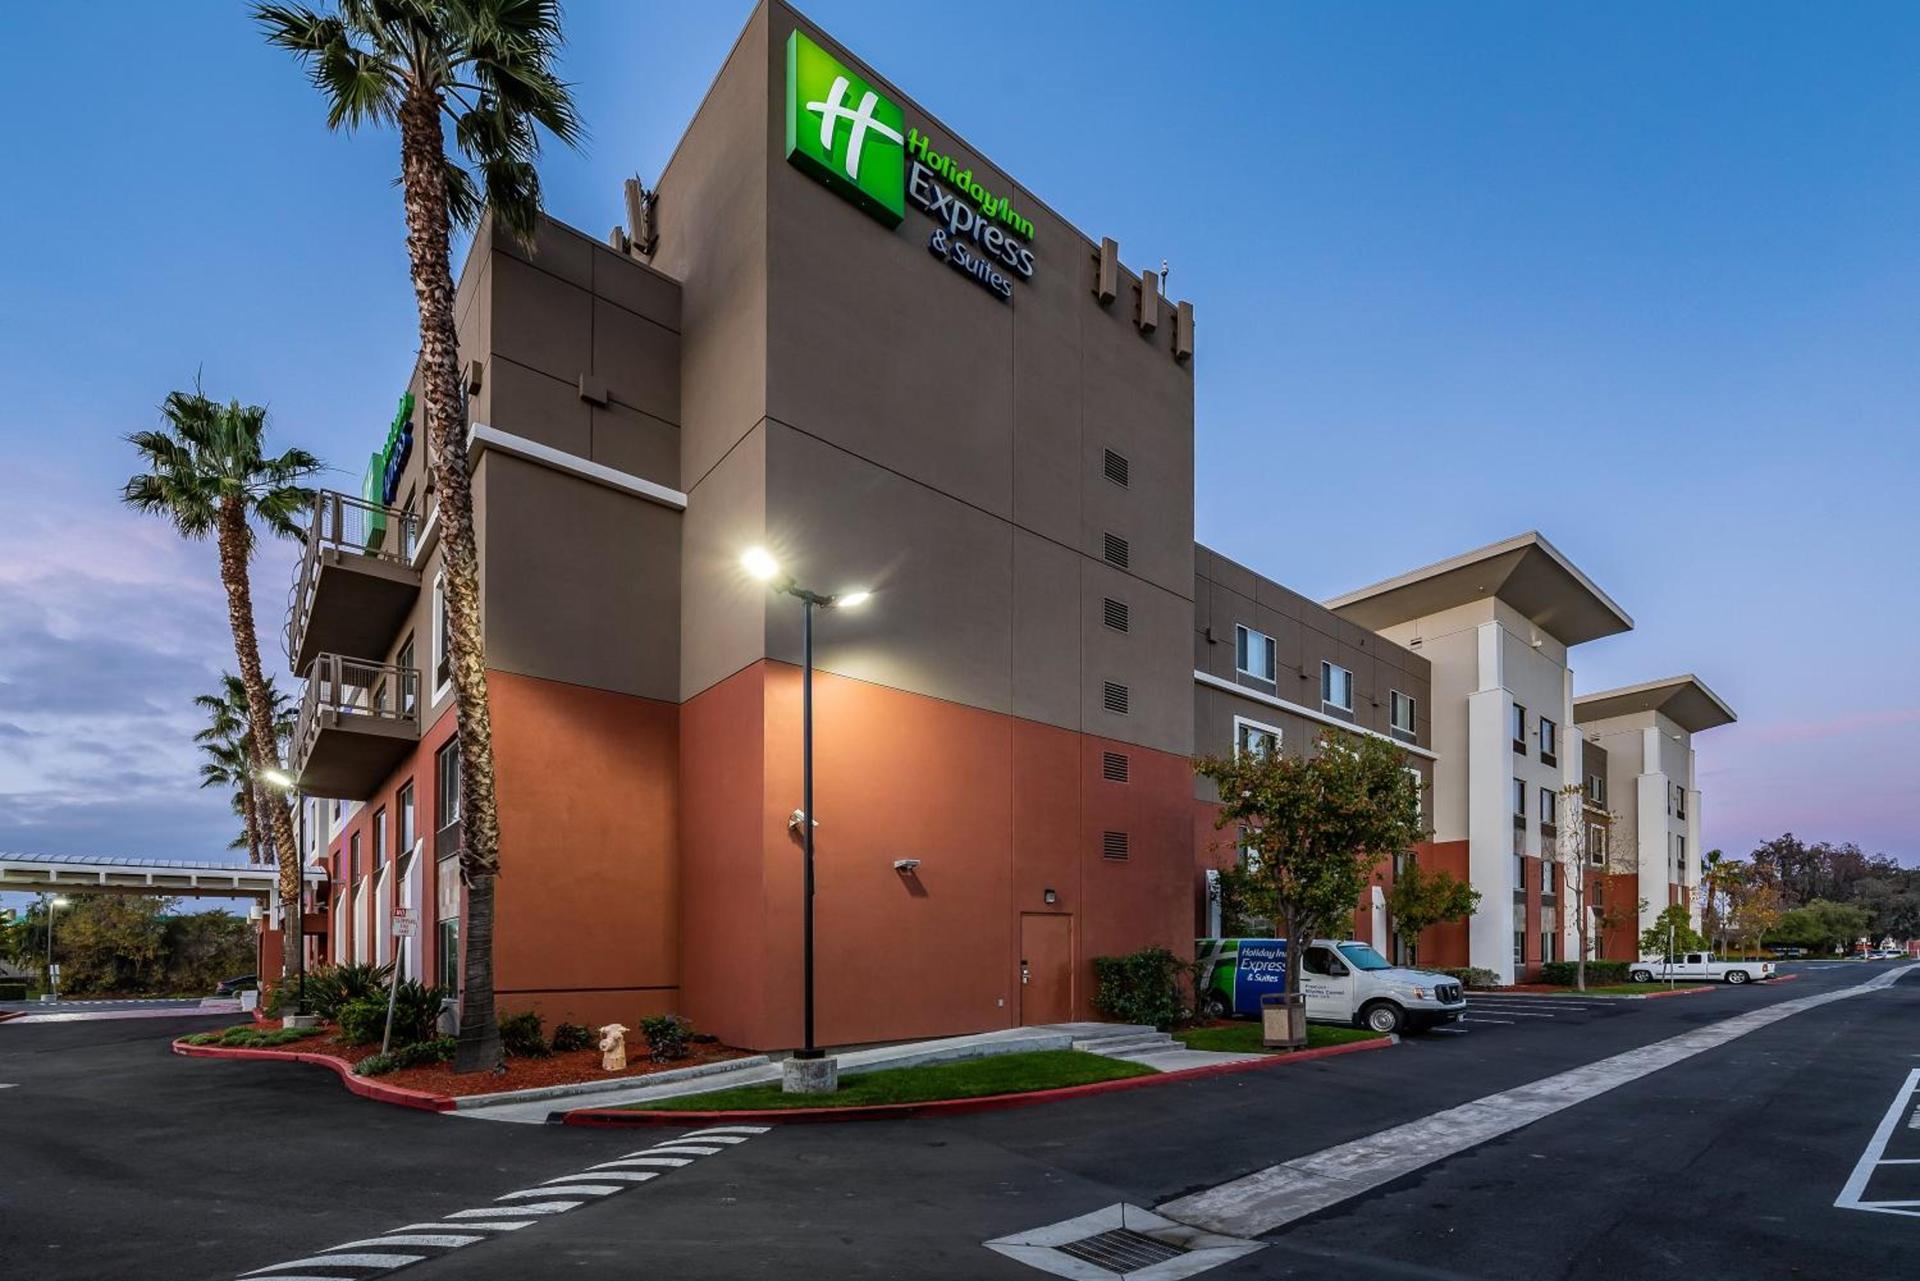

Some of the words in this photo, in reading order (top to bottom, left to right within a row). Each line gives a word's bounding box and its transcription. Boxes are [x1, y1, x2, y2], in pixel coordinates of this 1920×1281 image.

[909, 160, 1035, 277] Express
[932, 228, 948, 255] &
[953, 242, 1012, 297] Suites
[1242, 948, 1275, 959] Holiday
[1247, 973, 1253, 981] &
[1255, 973, 1279, 982] Suites
